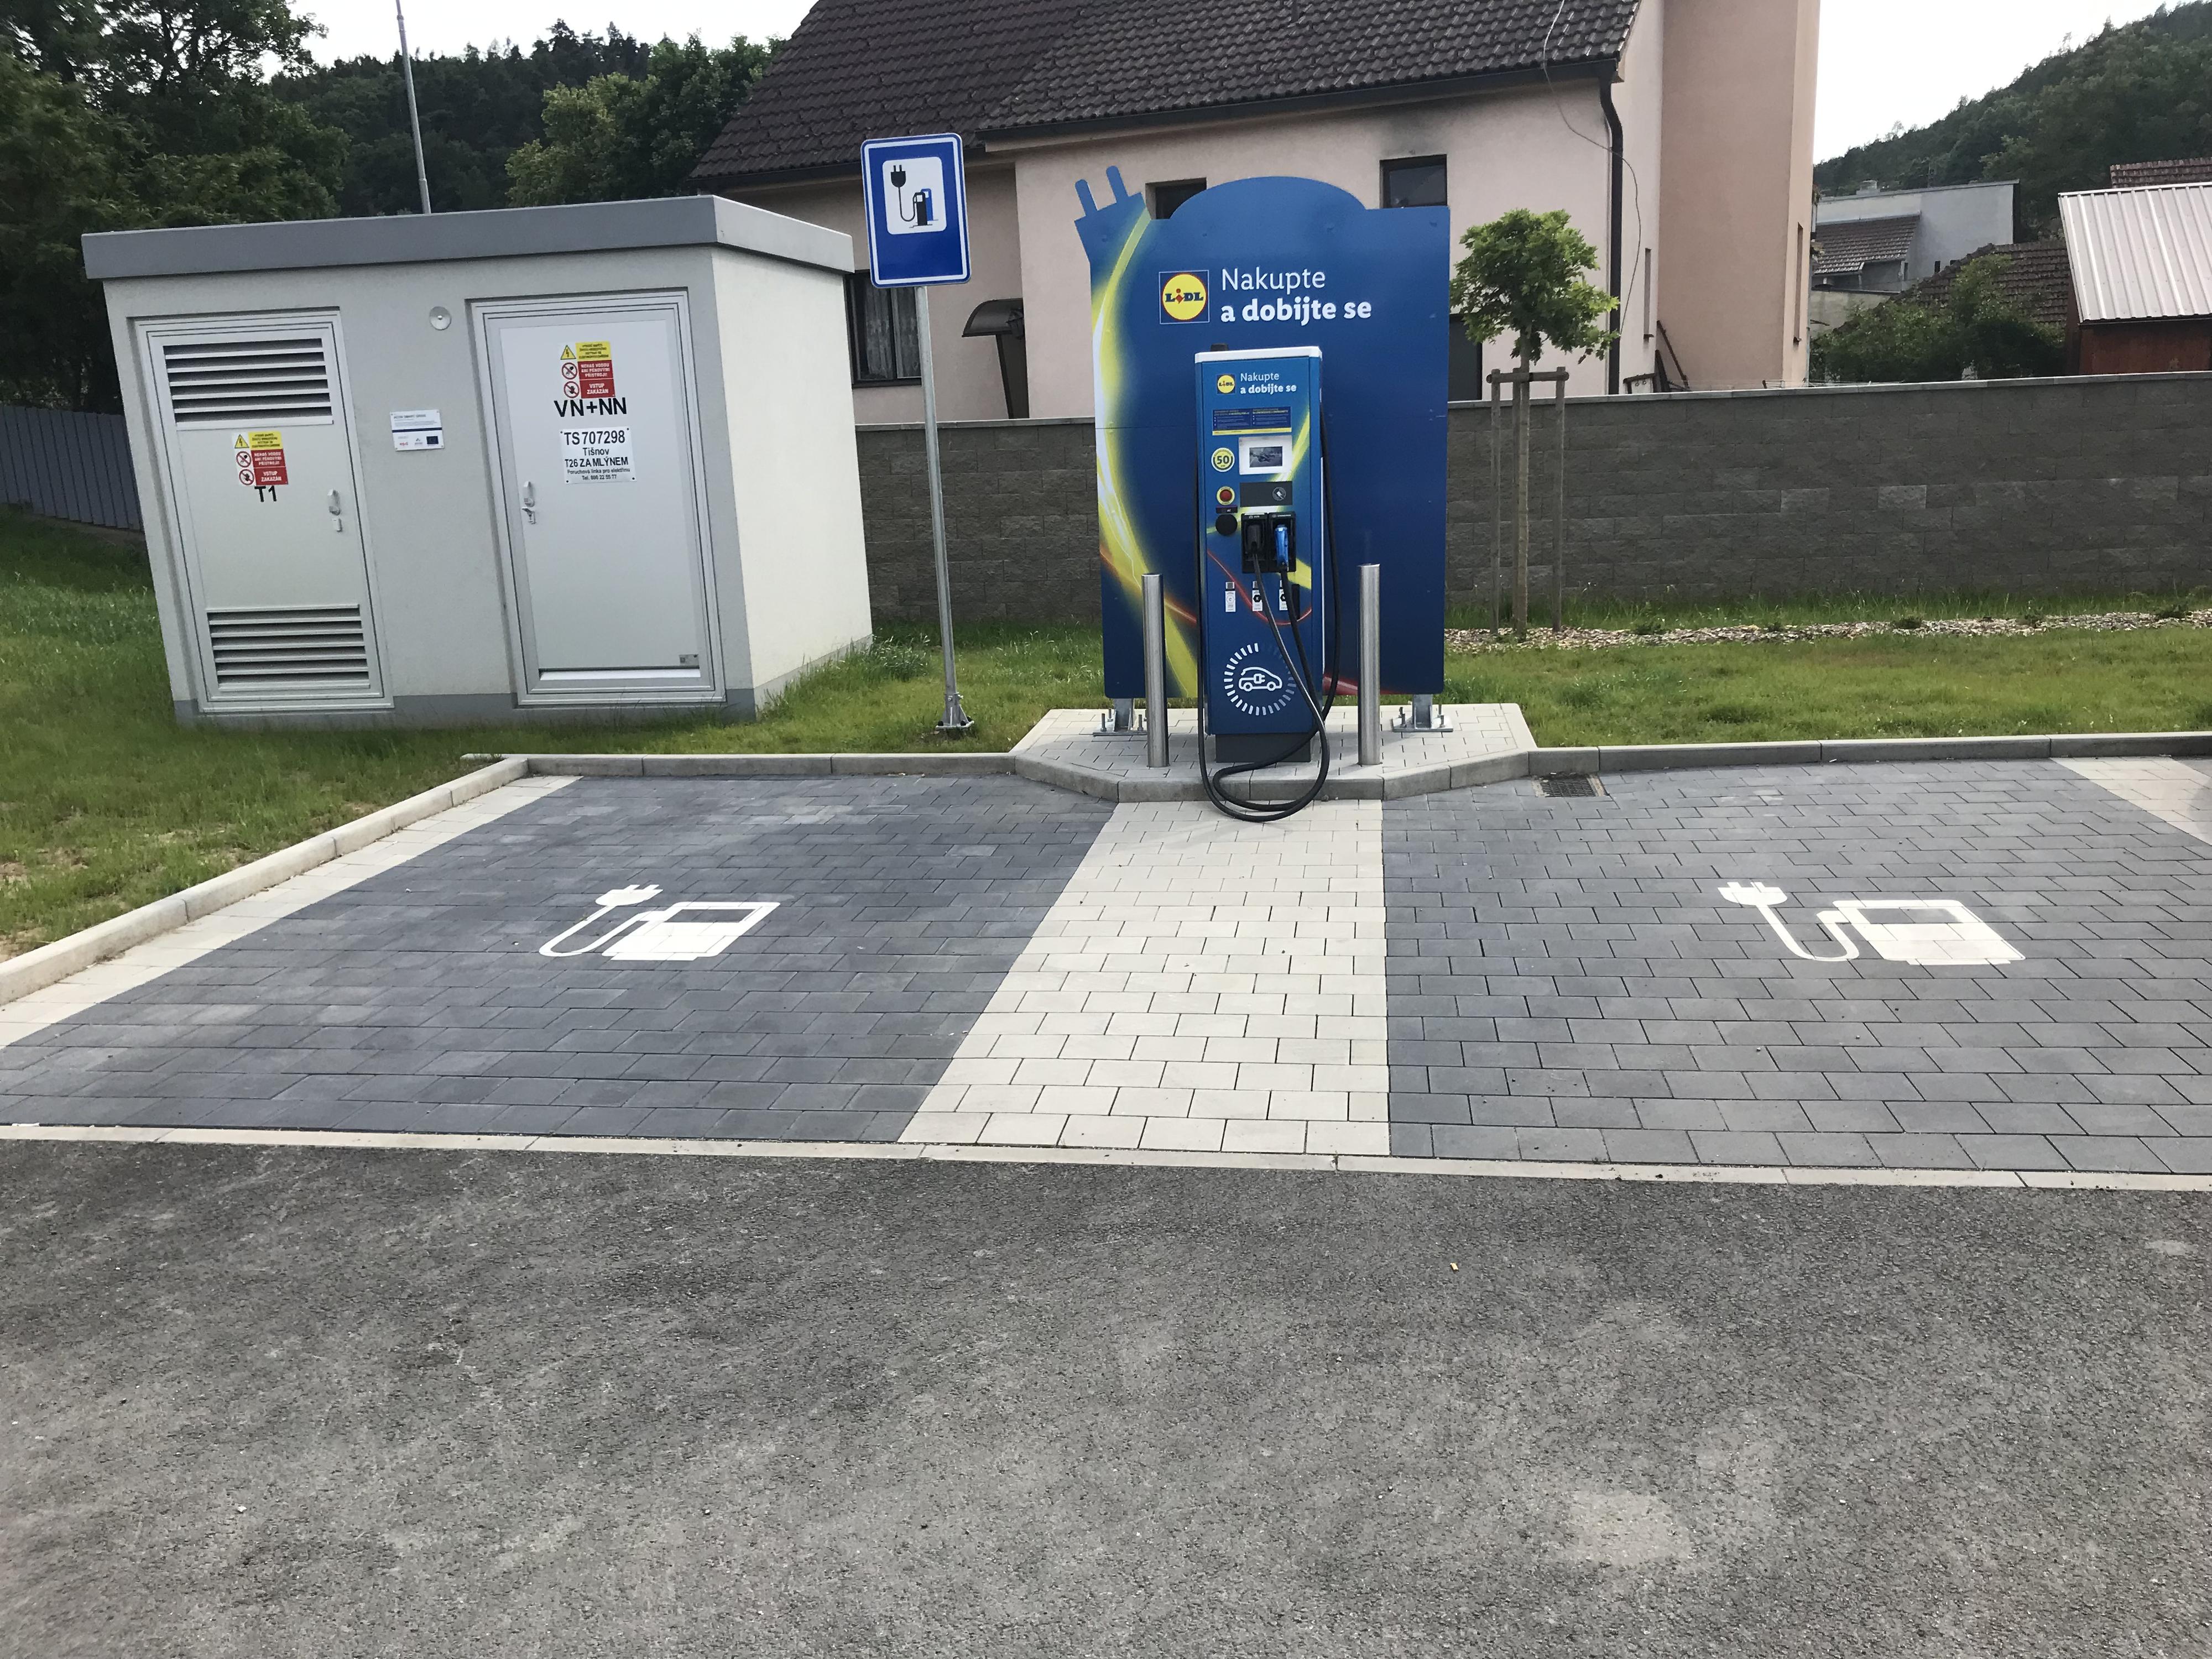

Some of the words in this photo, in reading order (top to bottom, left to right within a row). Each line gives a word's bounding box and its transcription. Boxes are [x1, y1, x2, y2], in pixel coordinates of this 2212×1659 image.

[1222, 267, 1326, 294] Nakupte
[1220, 305, 1235, 322] a
[1242, 297, 1337, 326] dobijte
[1343, 301, 1372, 319] se
[1240, 372, 1279, 382] Nakupte
[1248, 384, 1284, 395] dobijte
[564, 432, 580, 445] TS
[582, 430, 625, 445] 707298
[582, 447, 609, 456] Tišnov
[565, 458, 578, 467] T26
[580, 458, 592, 467] ZA
[592, 456, 629, 466] MLÝNEM
[1217, 455, 1230, 465] 50
